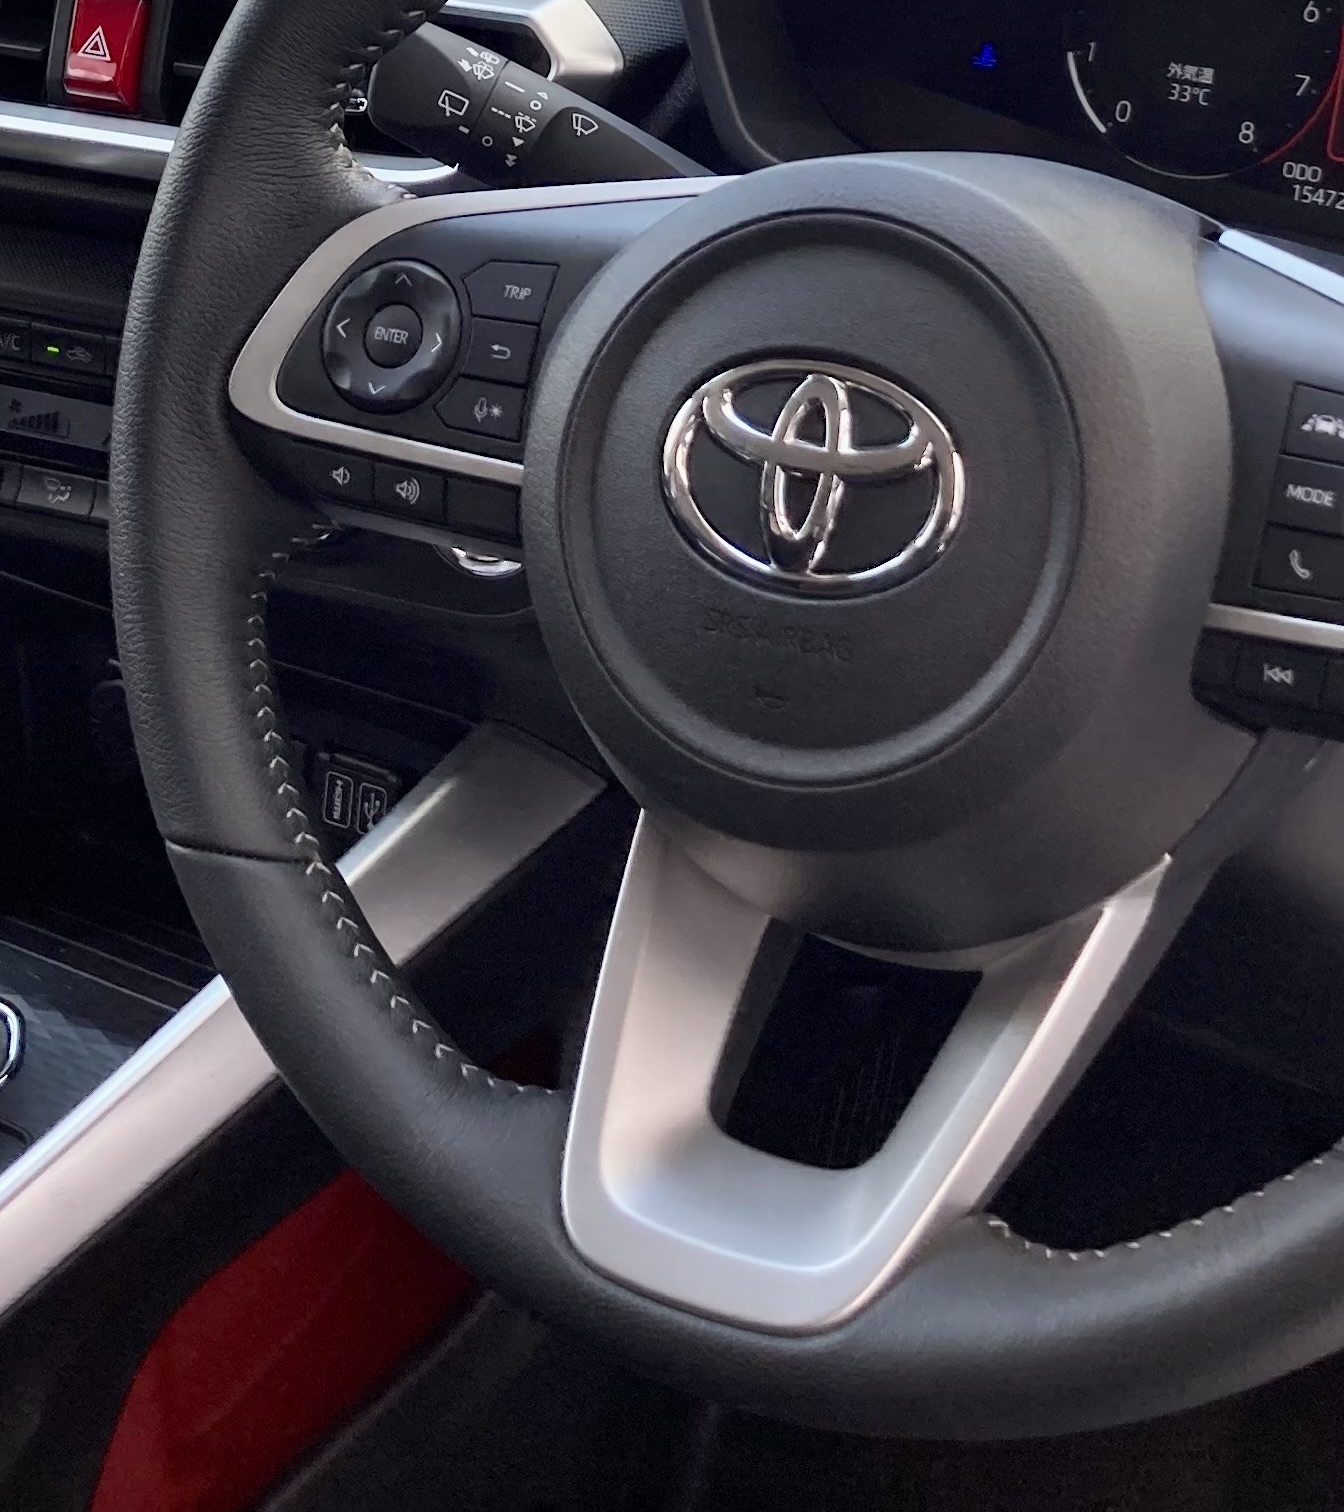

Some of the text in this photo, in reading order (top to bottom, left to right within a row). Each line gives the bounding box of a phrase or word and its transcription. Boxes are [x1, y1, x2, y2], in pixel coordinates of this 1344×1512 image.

[1303, 0, 1320, 23] 6
[1087, 41, 1098, 63] 1
[1294, 73, 1312, 97] 7
[1115, 100, 1132, 123] 0
[1238, 121, 1255, 144] 8
[1282, 161, 1323, 184] ODO
[503, 284, 532, 301] TRIP
[374, 326, 409, 345] ENTER
[1284, 482, 1337, 508] MODE
